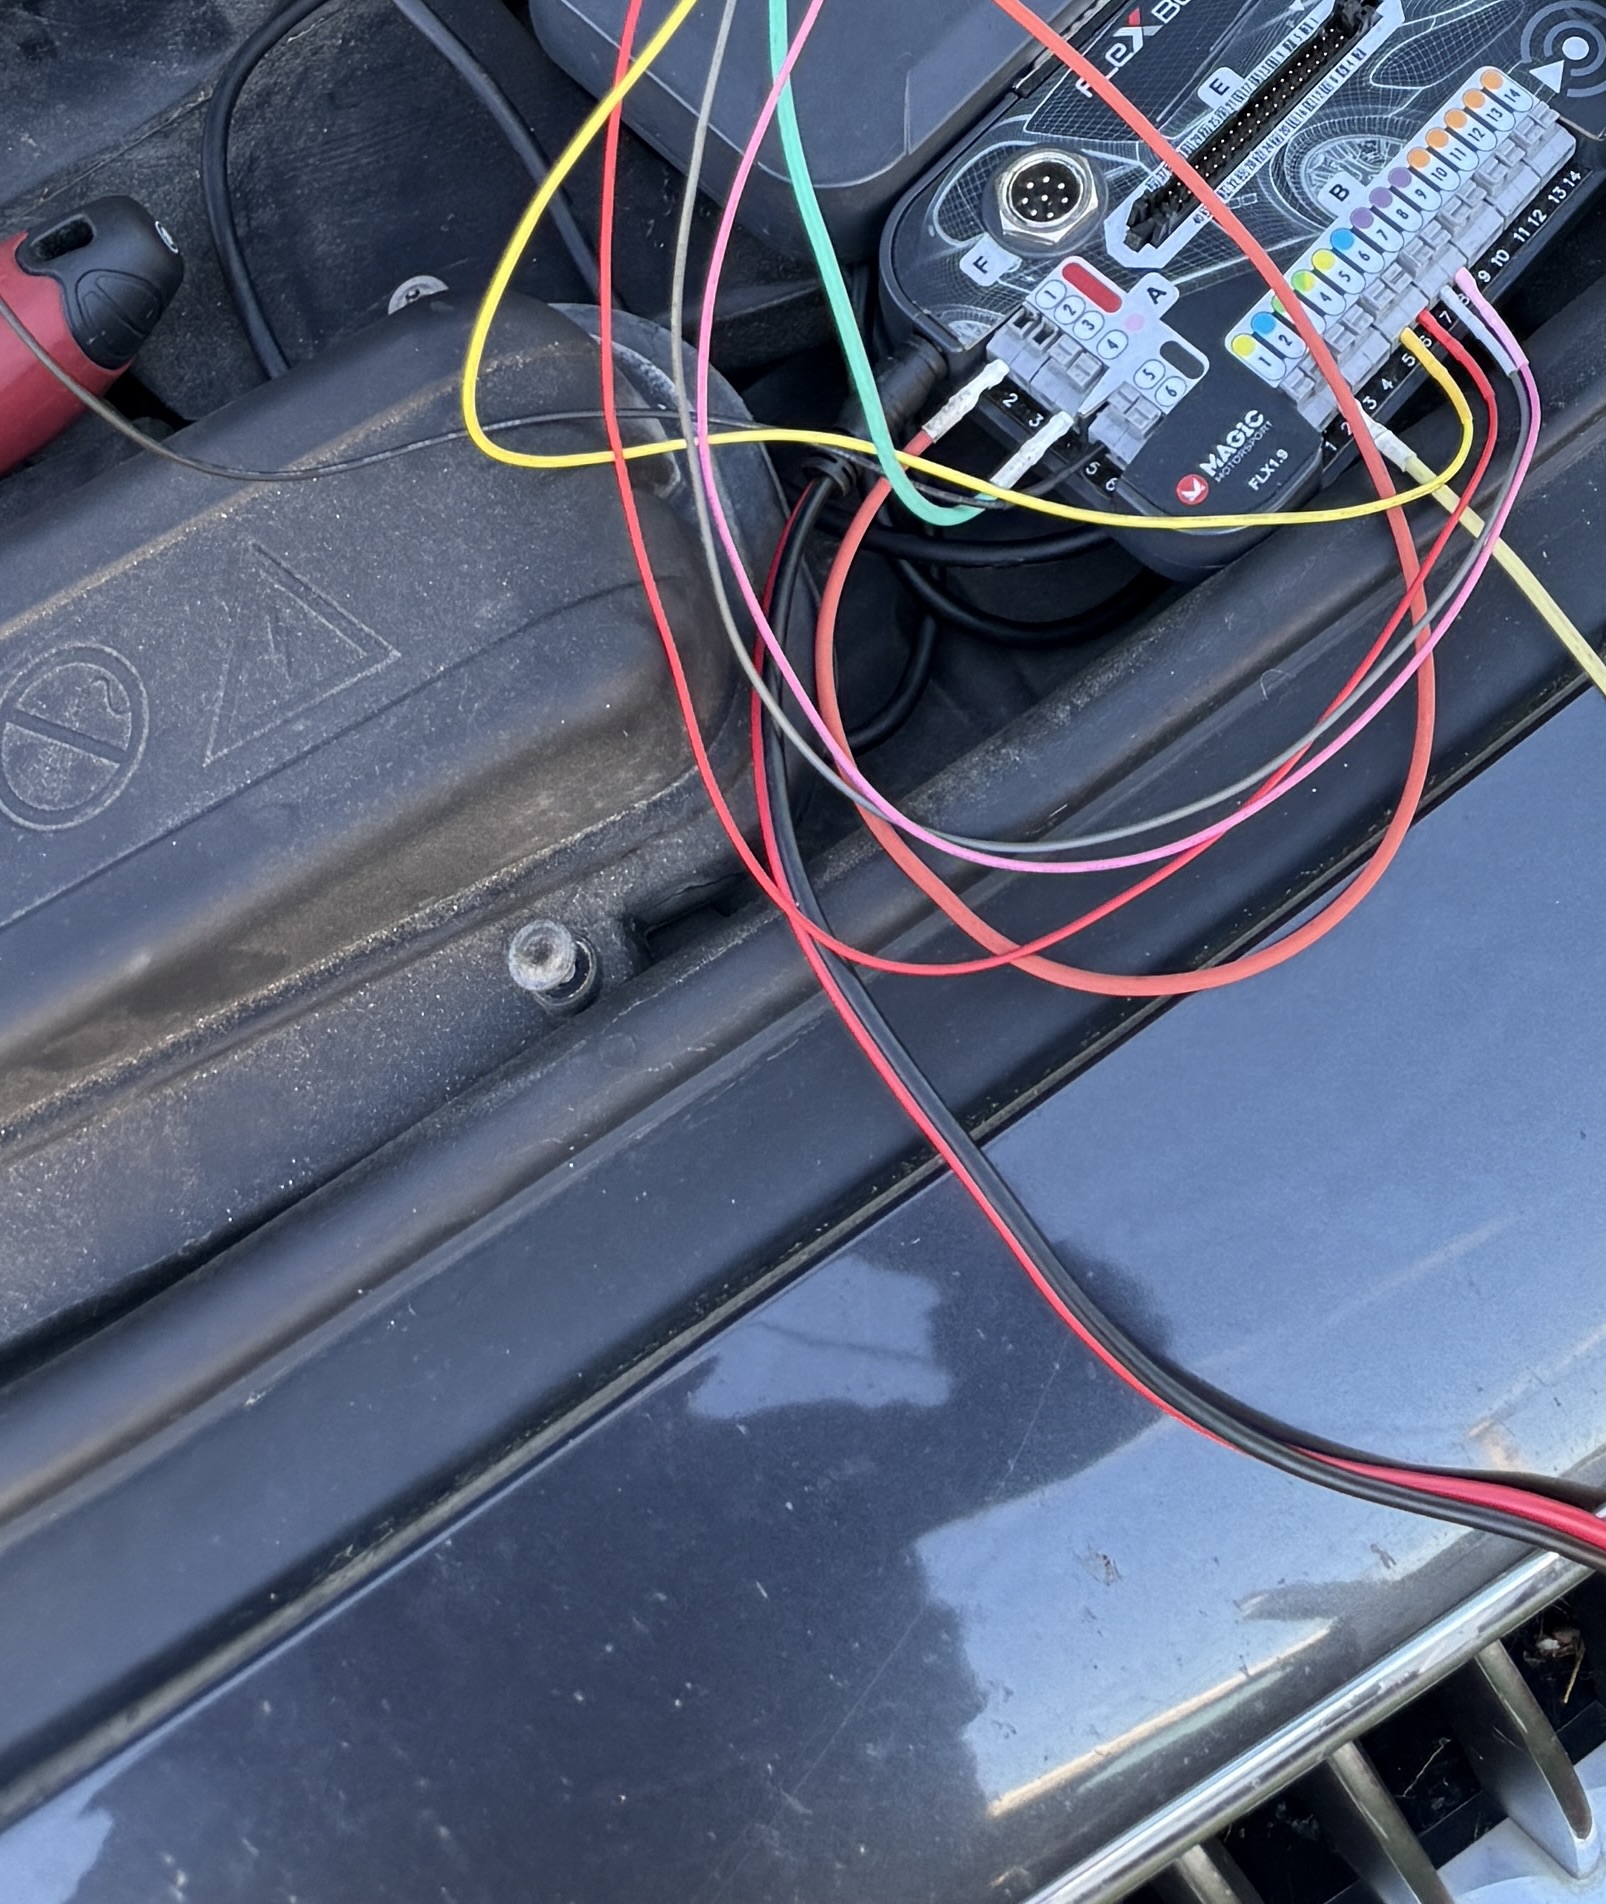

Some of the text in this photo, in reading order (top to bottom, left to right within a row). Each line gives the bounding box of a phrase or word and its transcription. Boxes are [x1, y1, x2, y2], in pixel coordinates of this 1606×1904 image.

[1208, 77, 1231, 97] E
[1506, 88, 1522, 103] 14
[1486, 108, 1504, 123] 13
[1468, 127, 1486, 143] 12
[1450, 148, 1467, 162] 11
[1430, 167, 1449, 182] 10
[1328, 182, 1350, 203] B
[1414, 188, 1428, 201] 9
[1395, 207, 1410, 220] 8
[1376, 228, 1391, 241] 7
[1358, 250, 1372, 263] 6
[972, 255, 990, 274] F
[1338, 270, 1351, 283] 5
[1148, 284, 1168, 306] A
[1318, 290, 1332, 303] 4
[1279, 333, 1294, 346] 2
[1258, 355, 1272, 368] 1
[1214, 420, 1274, 483] MOTORSPORT
[1247, 448, 1289, 491] FLX1.9
